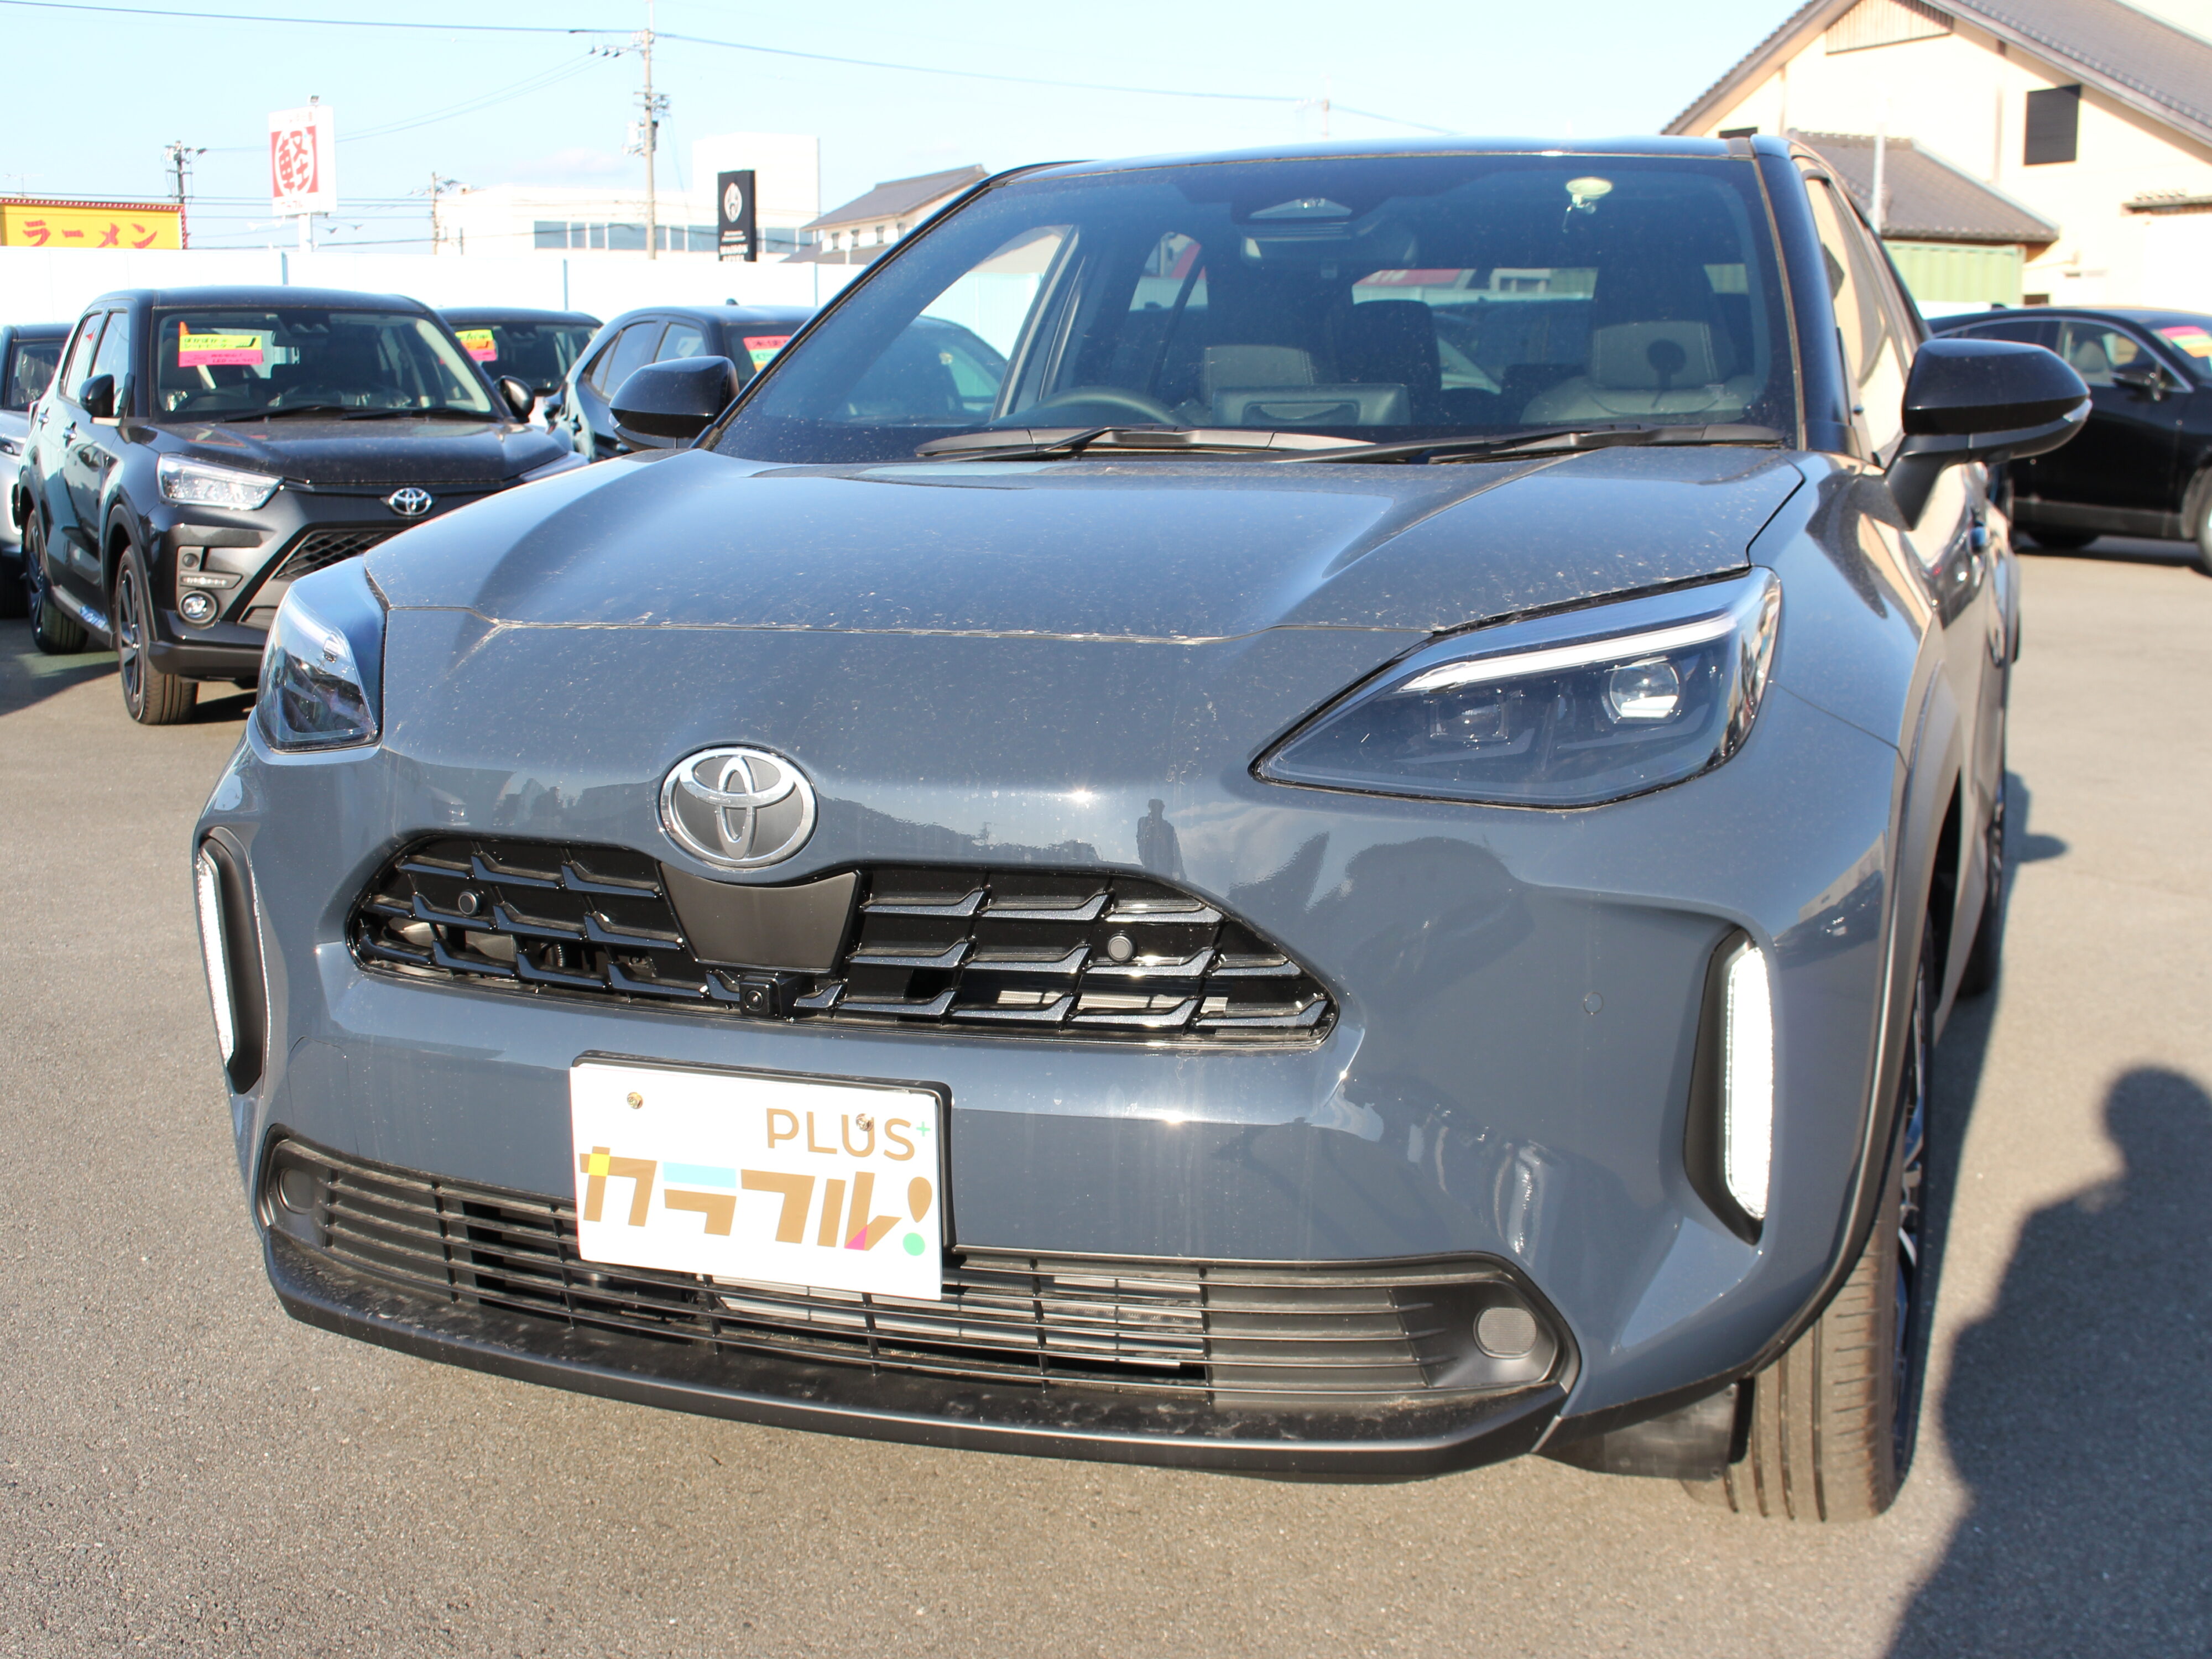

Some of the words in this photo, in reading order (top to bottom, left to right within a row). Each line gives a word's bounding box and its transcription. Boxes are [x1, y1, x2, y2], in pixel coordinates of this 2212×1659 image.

[278, 130, 310, 194] 軽
[22, 219, 158, 249] ラーメン
